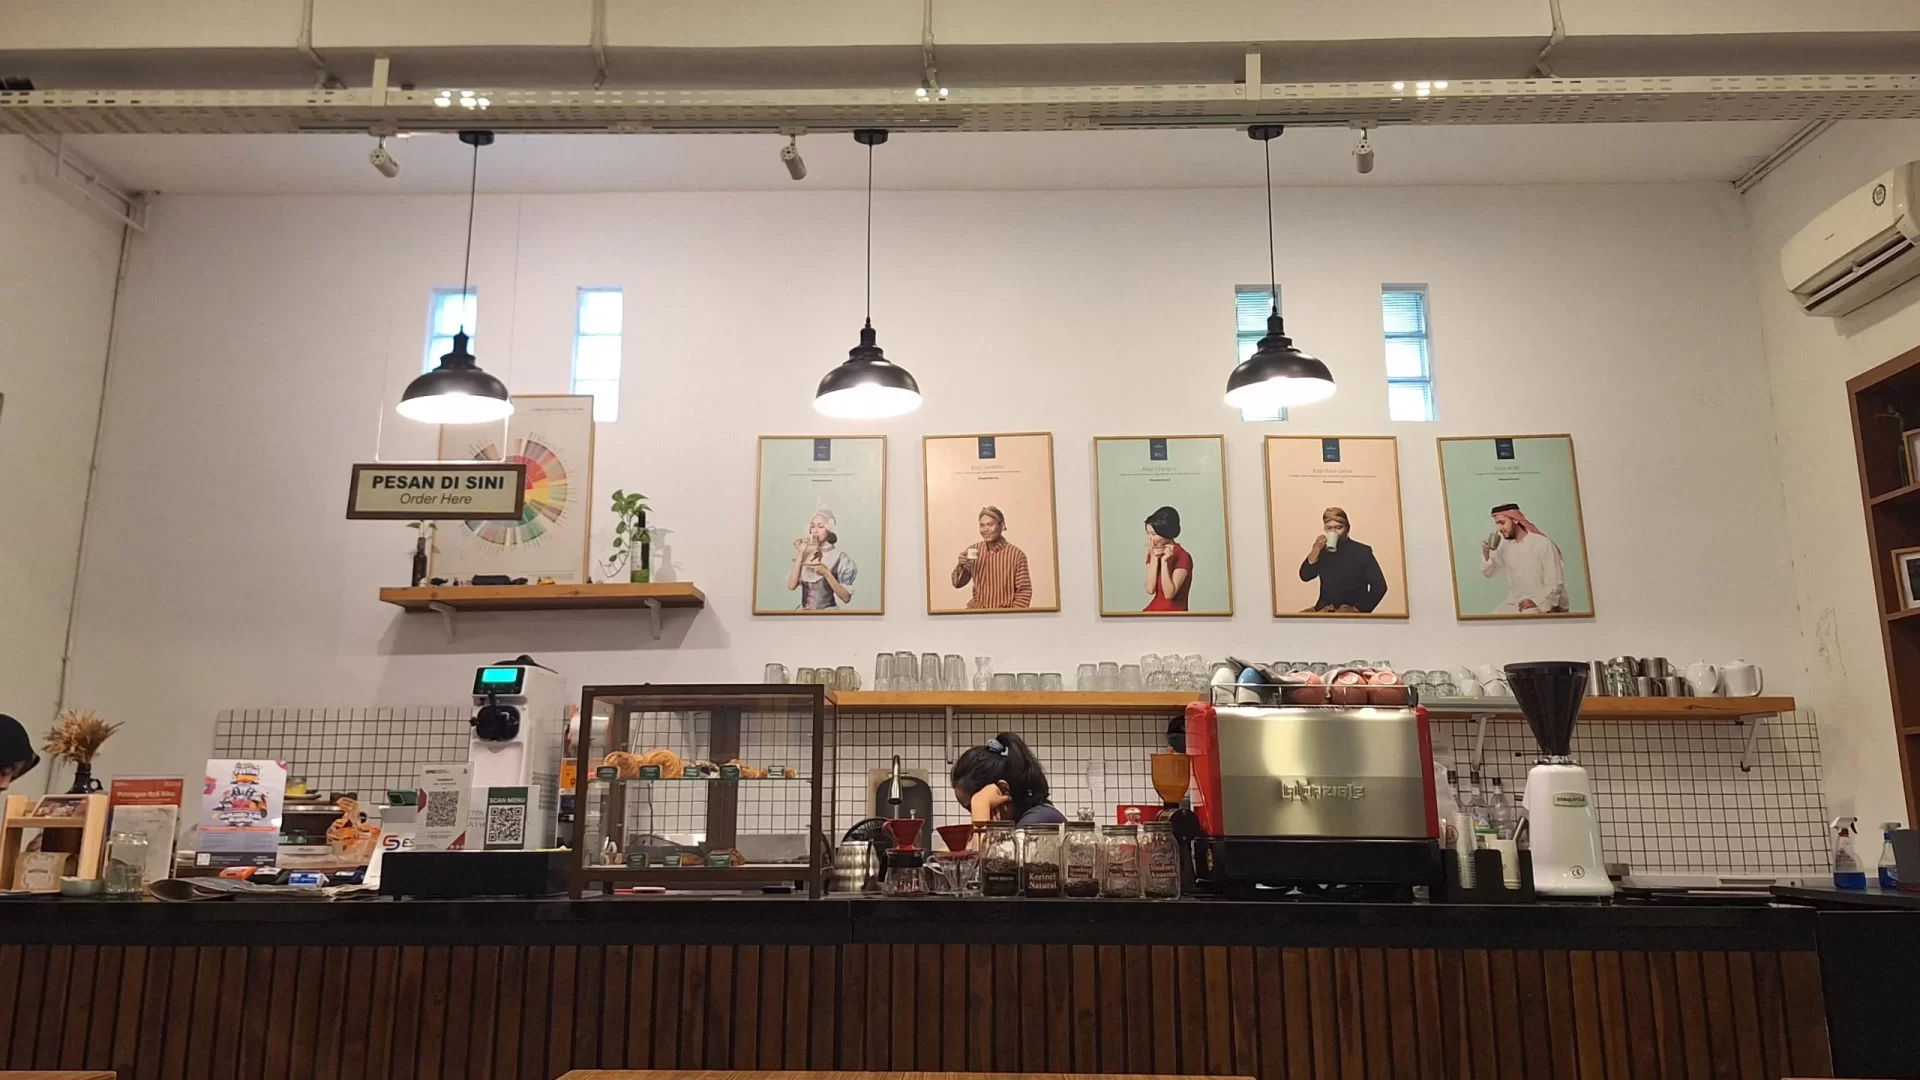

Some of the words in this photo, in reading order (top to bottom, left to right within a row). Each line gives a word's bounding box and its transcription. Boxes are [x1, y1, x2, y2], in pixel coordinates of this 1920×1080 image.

[372, 475, 435, 489] PESAN
[441, 475, 459, 489] DI
[465, 476, 504, 489] SINI
[400, 493, 438, 504] Order
[440, 493, 472, 505] Here
[1029, 872, 1056, 880] Kerinci
[1028, 881, 1057, 889] Natural
